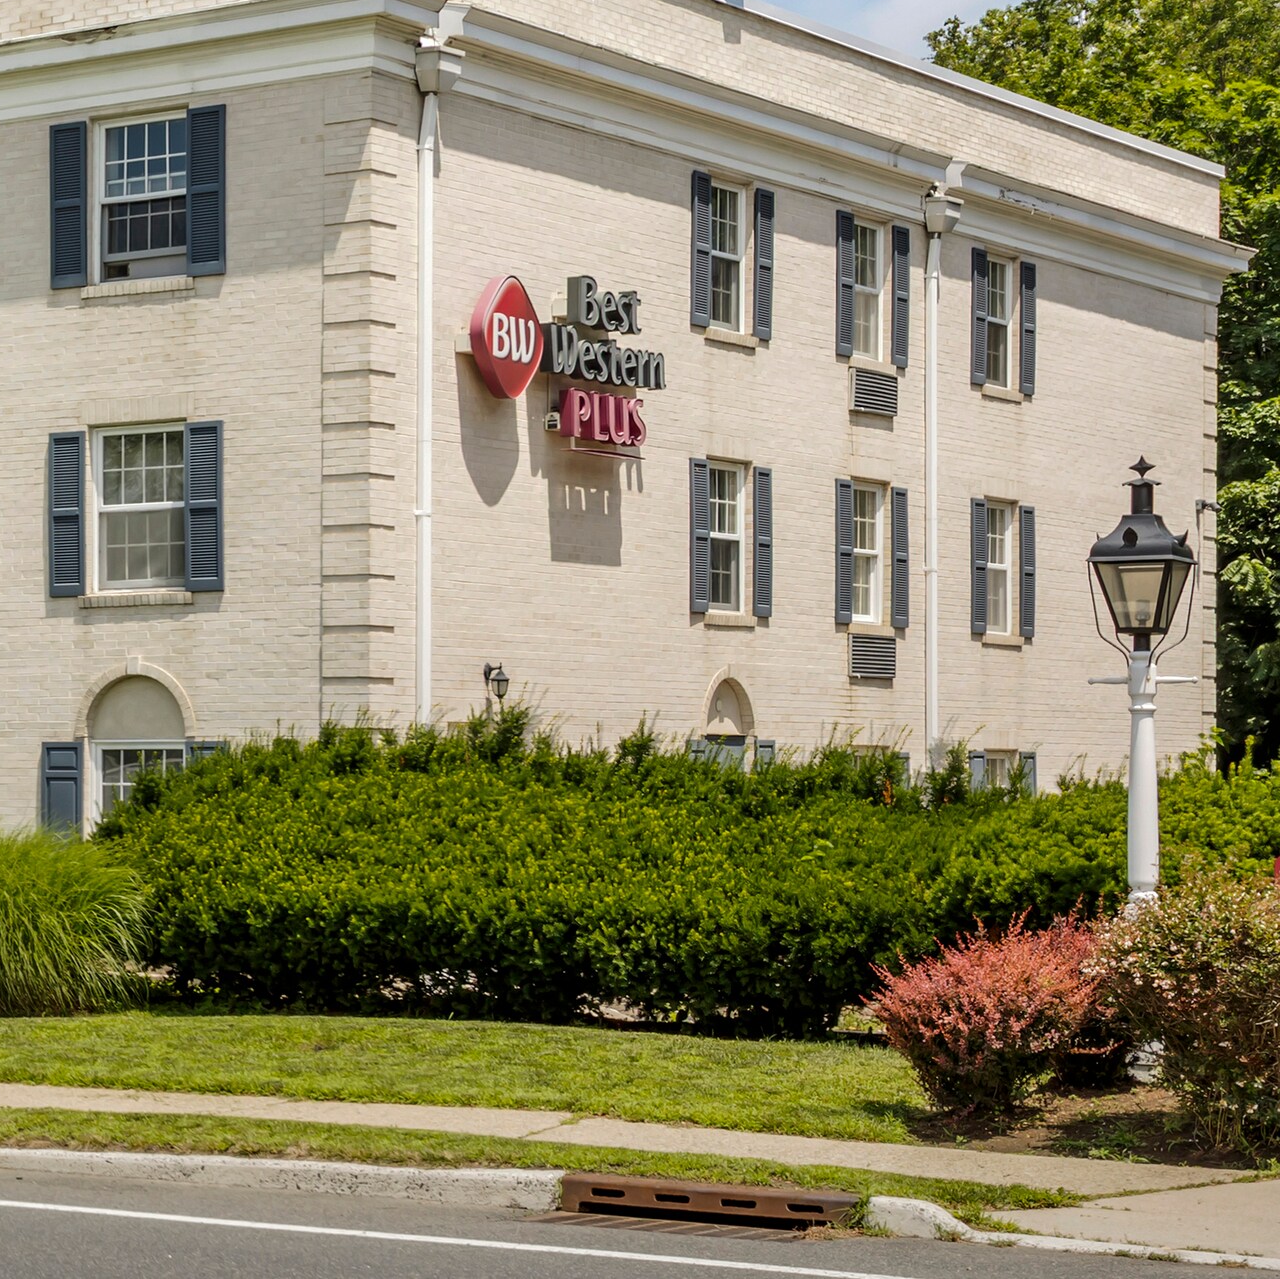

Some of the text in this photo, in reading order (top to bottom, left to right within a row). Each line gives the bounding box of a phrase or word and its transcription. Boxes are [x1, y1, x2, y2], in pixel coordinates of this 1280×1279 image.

[575, 275, 642, 335] Best
[492, 313, 536, 365] BW
[546, 322, 667, 390] Western
[568, 387, 647, 447] PLUS
